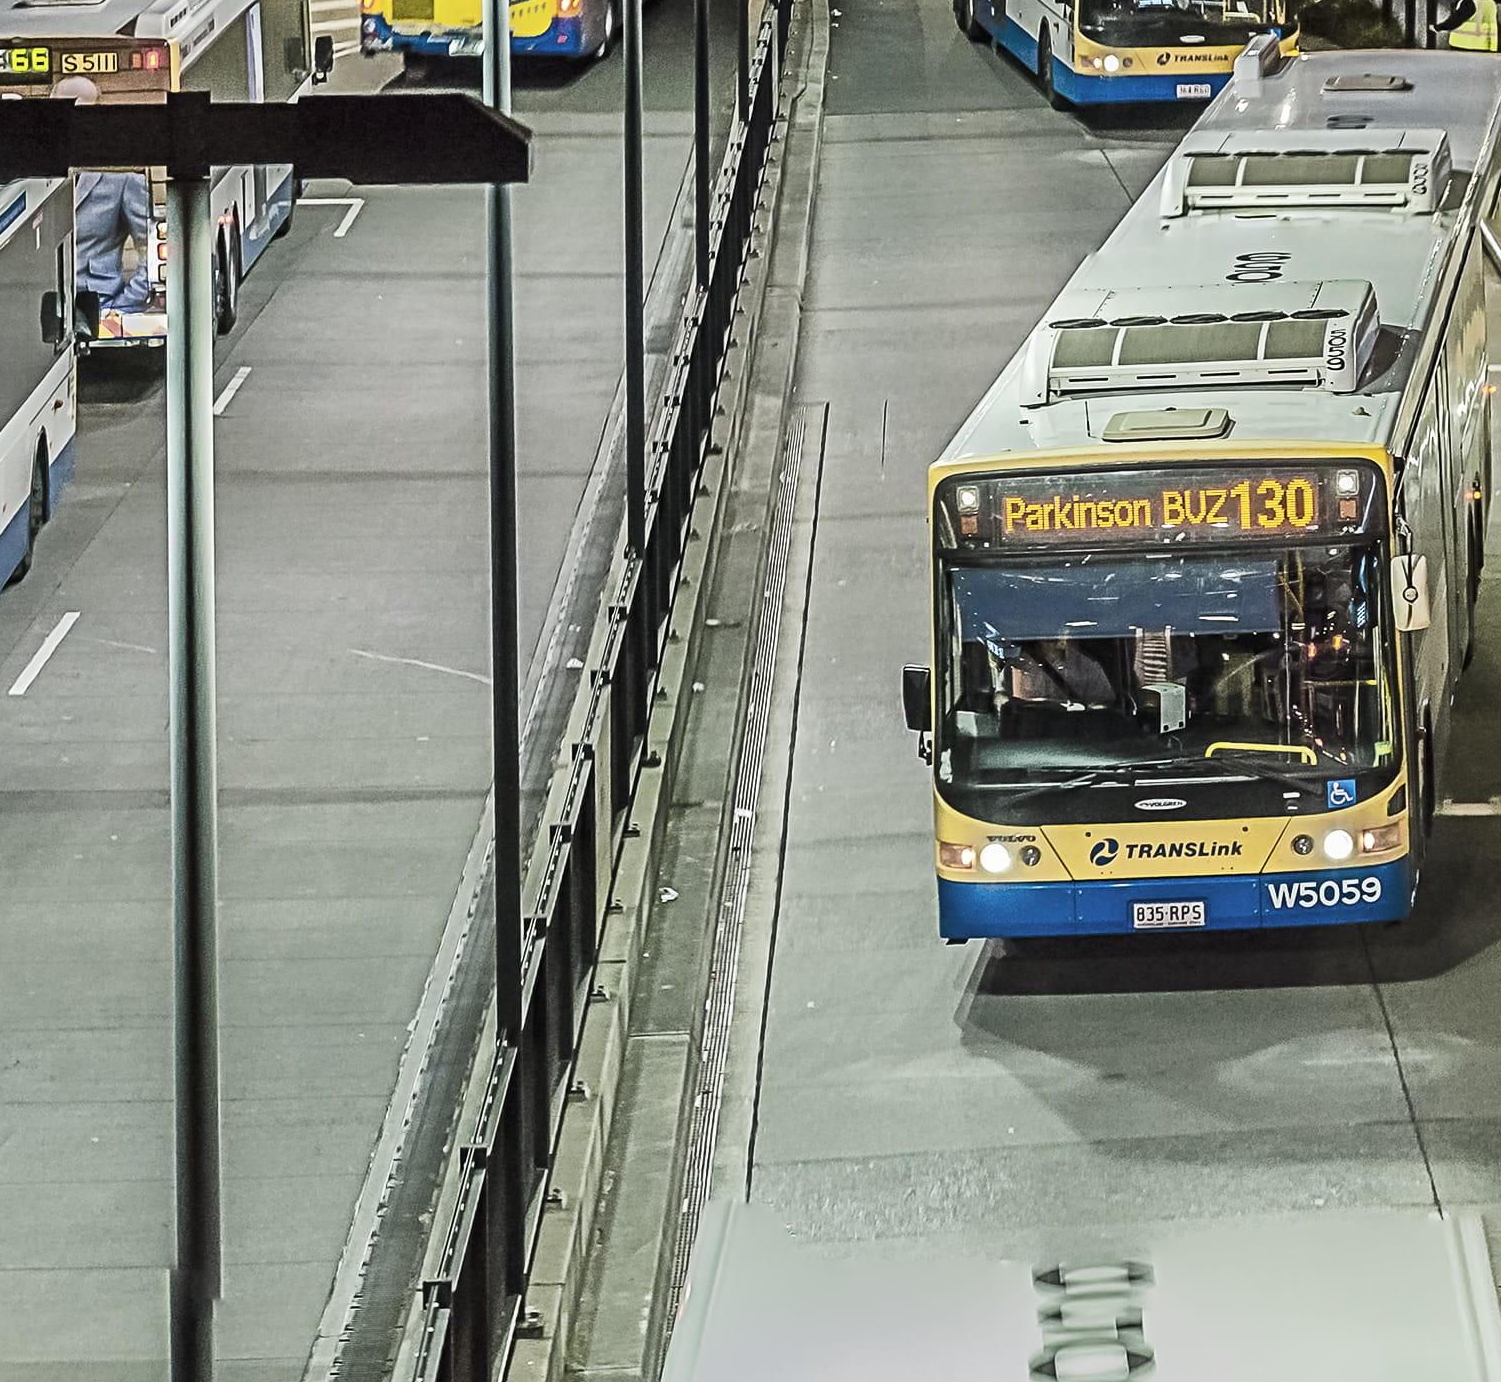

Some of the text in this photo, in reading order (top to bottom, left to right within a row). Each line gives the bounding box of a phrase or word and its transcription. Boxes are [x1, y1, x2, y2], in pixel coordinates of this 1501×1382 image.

[11, 47, 49, 72] 66
[1005, 478, 1315, 534] Parkinson BUZ 130
[1126, 841, 1243, 859] TRANSLink
[1268, 876, 1382, 909] W5059
